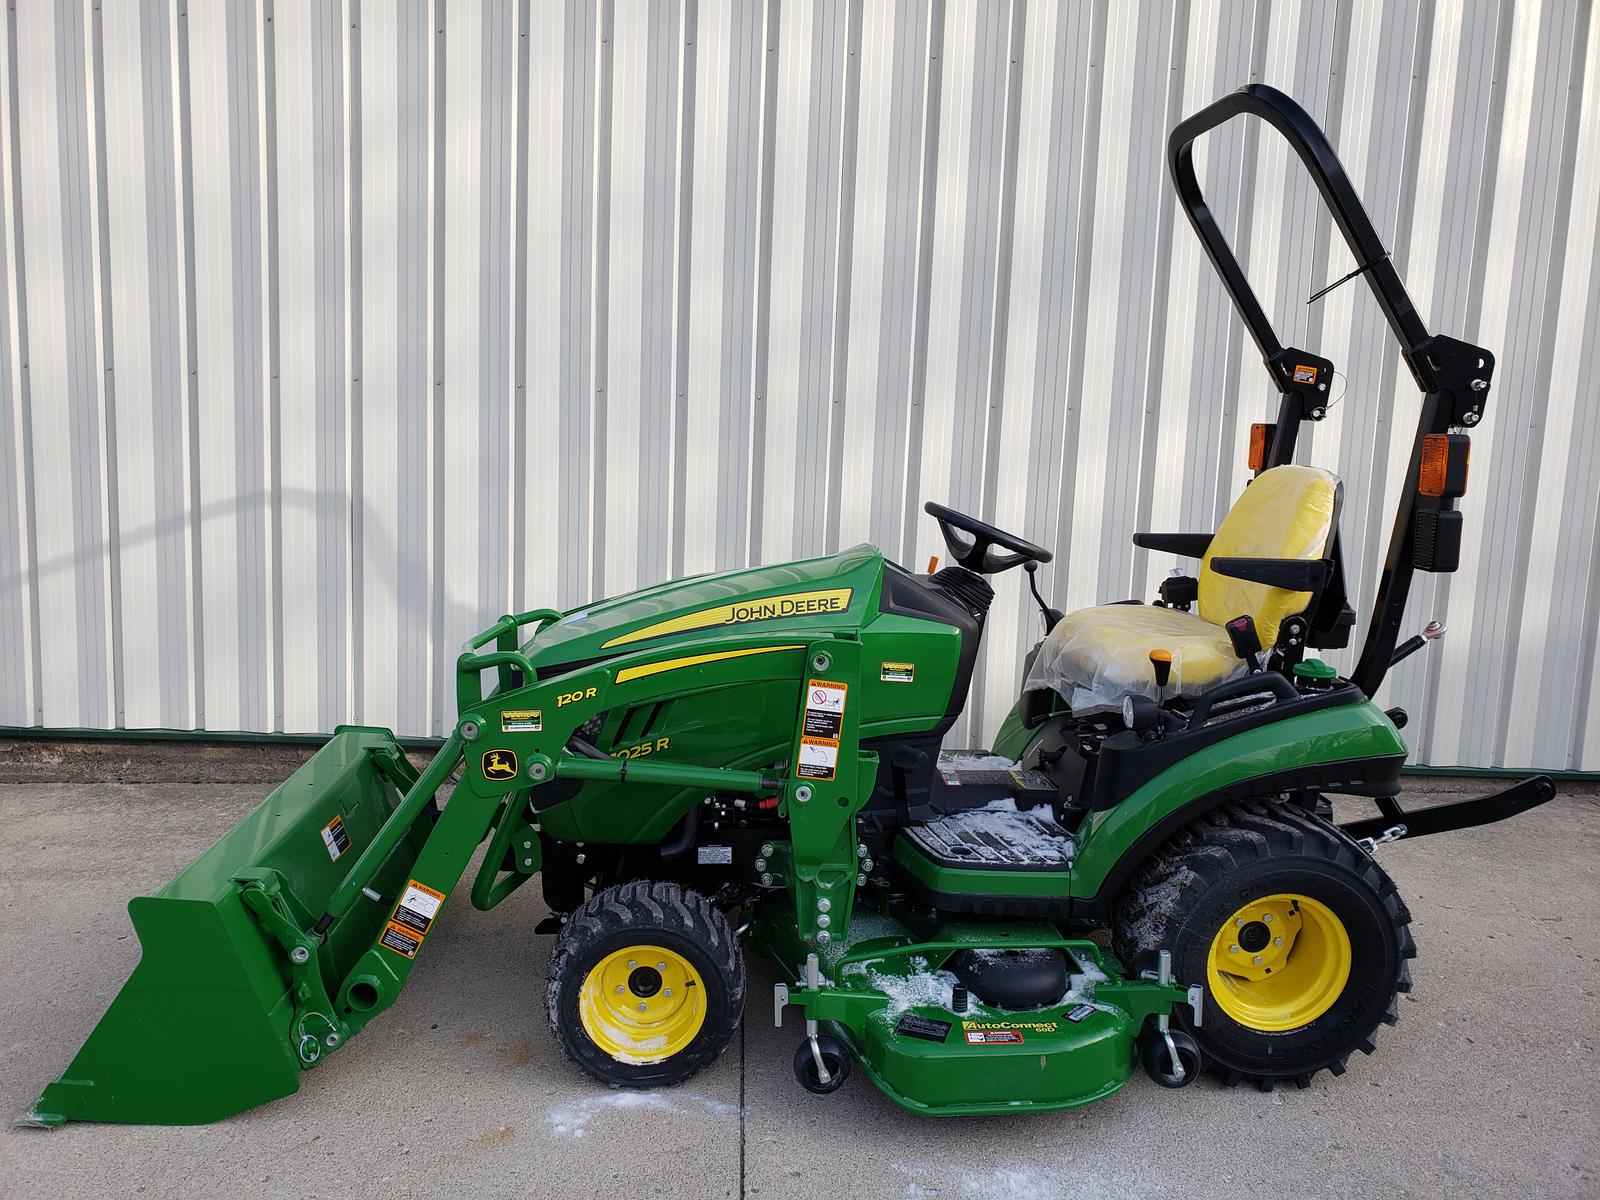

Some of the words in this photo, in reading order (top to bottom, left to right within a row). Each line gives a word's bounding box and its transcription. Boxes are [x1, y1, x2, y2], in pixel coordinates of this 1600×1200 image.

[725, 604, 775, 622] JOHN
[781, 598, 840, 615] DEERE
[816, 681, 846, 690] WARNING
[557, 691, 583, 707] 120
[586, 687, 597, 698] R
[656, 737, 670, 751] R
[809, 739, 837, 747] WARNING
[418, 885, 440, 898] WARNING
[397, 928, 420, 940] WARNING
[964, 1021, 1058, 1030] AutoConnect
